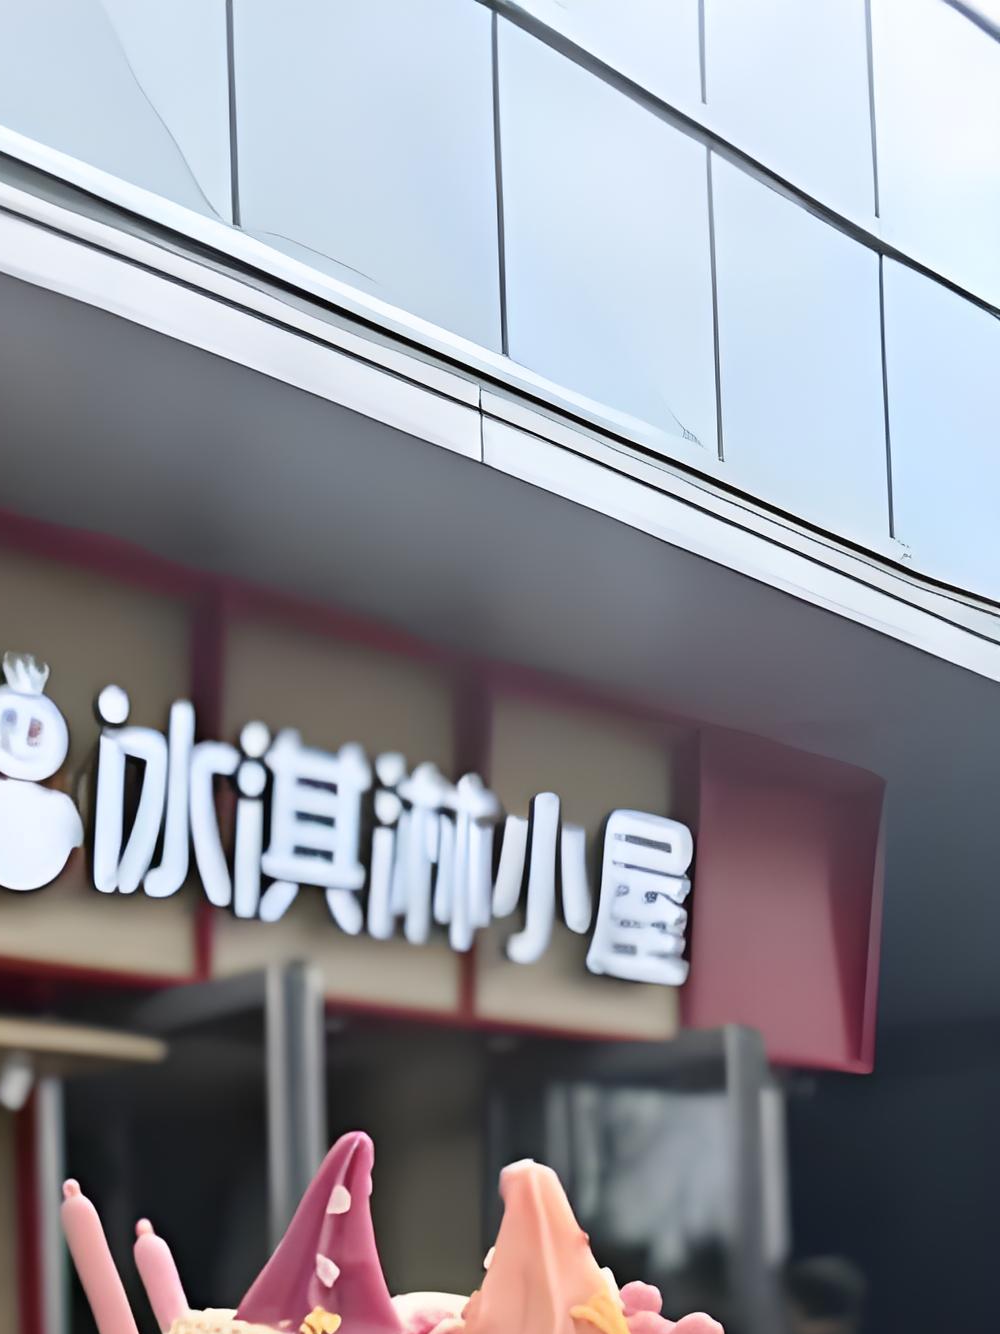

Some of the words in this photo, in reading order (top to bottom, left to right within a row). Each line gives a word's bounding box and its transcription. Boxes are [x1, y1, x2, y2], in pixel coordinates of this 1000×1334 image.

[93, 685, 694, 985] 冰淇淋小屋
